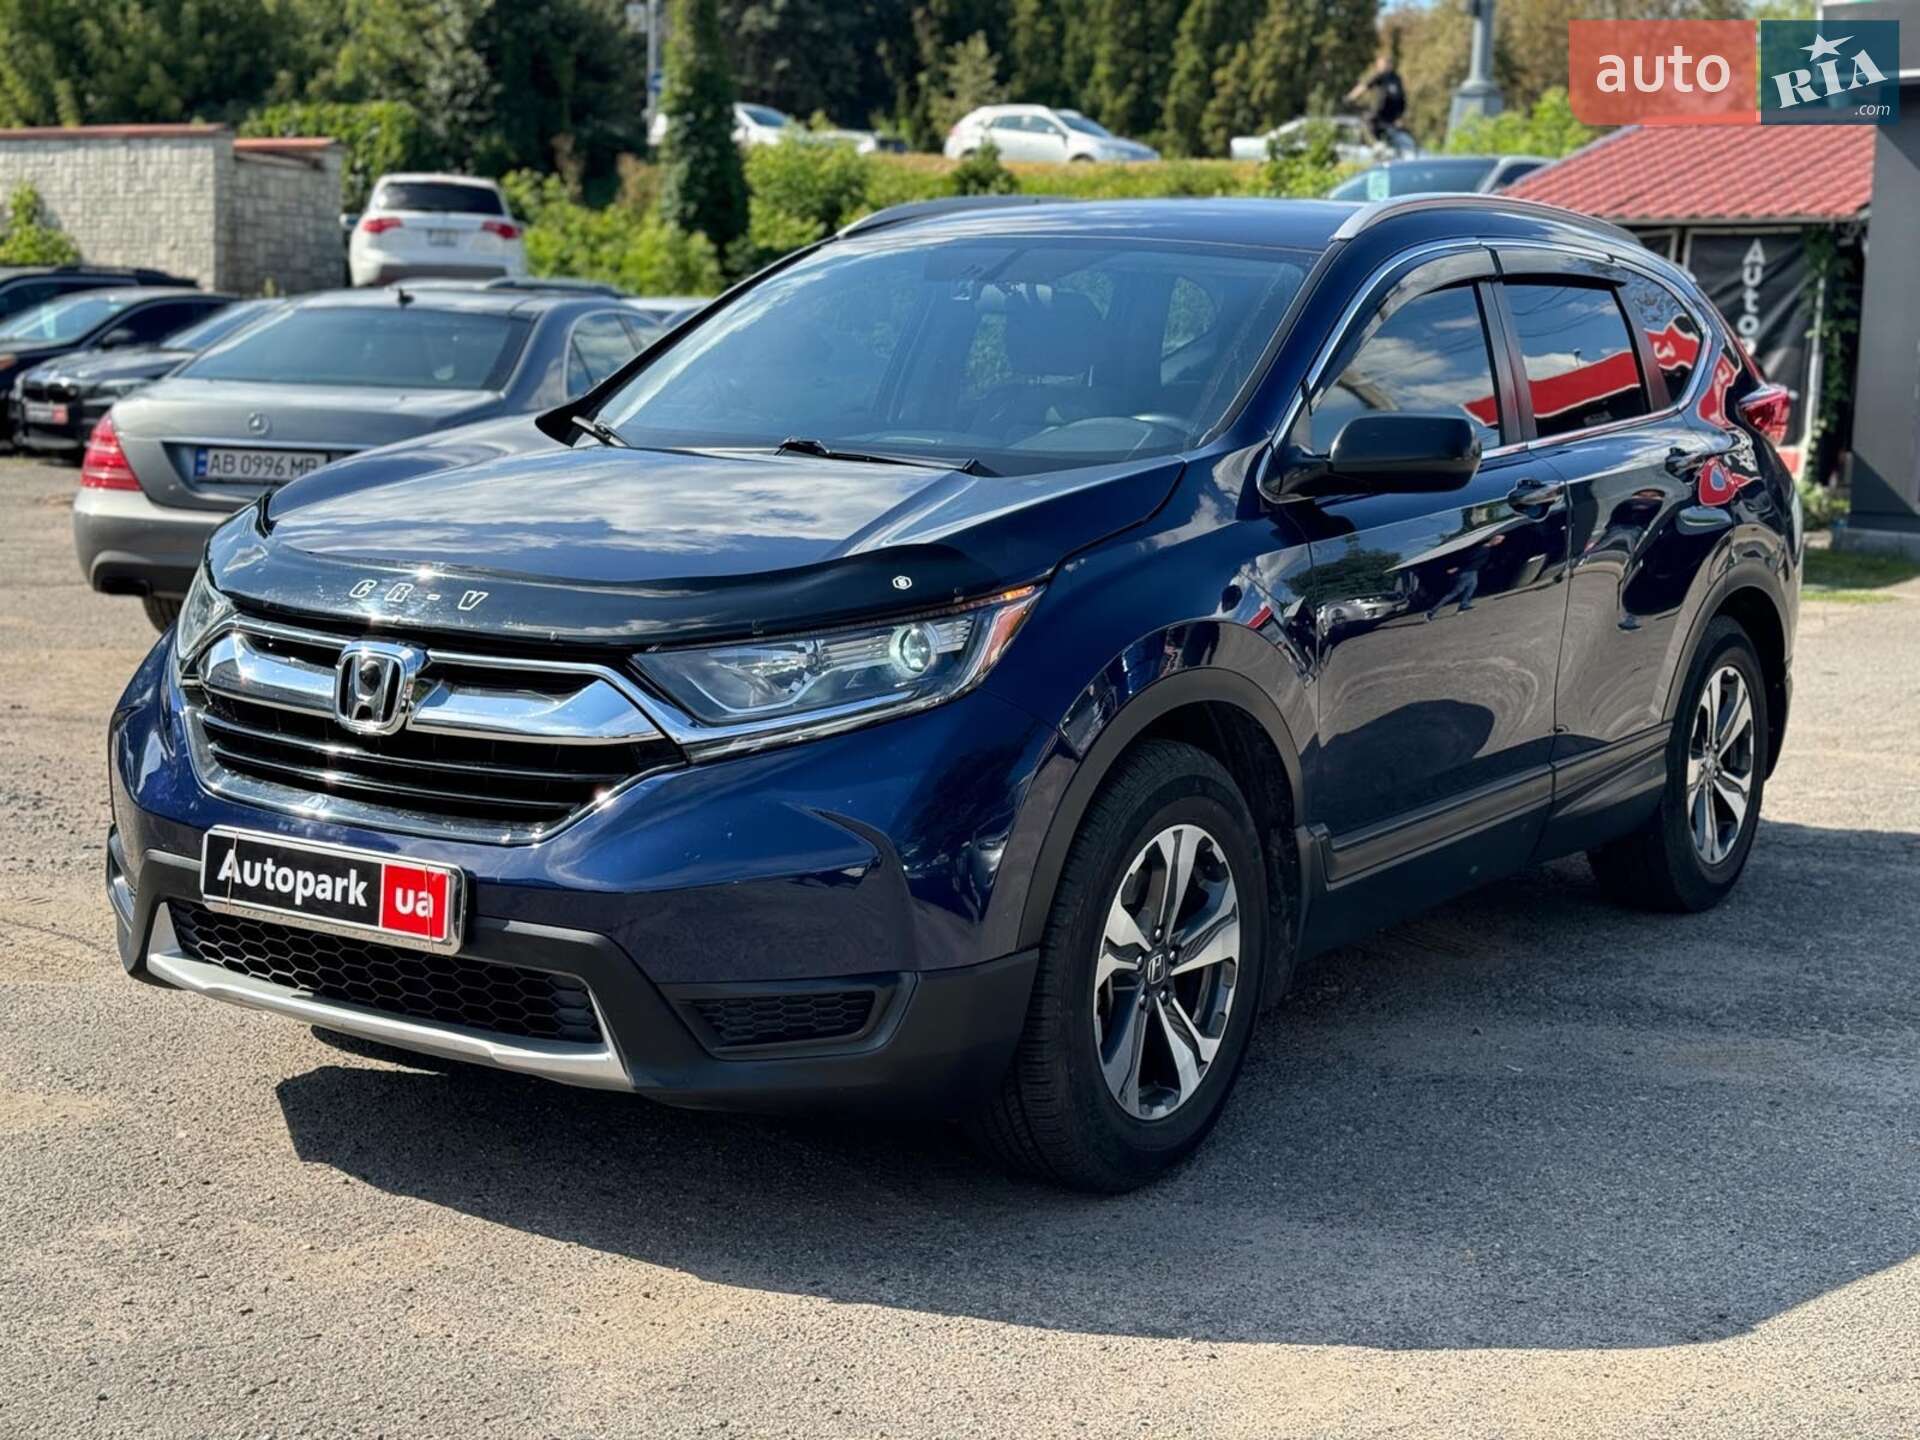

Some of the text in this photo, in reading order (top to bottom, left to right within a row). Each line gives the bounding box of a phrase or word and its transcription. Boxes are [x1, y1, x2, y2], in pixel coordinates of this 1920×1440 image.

[209, 453, 236, 474] AB
[240, 454, 286, 477] 0996
[216, 849, 434, 918] Autopark ua
